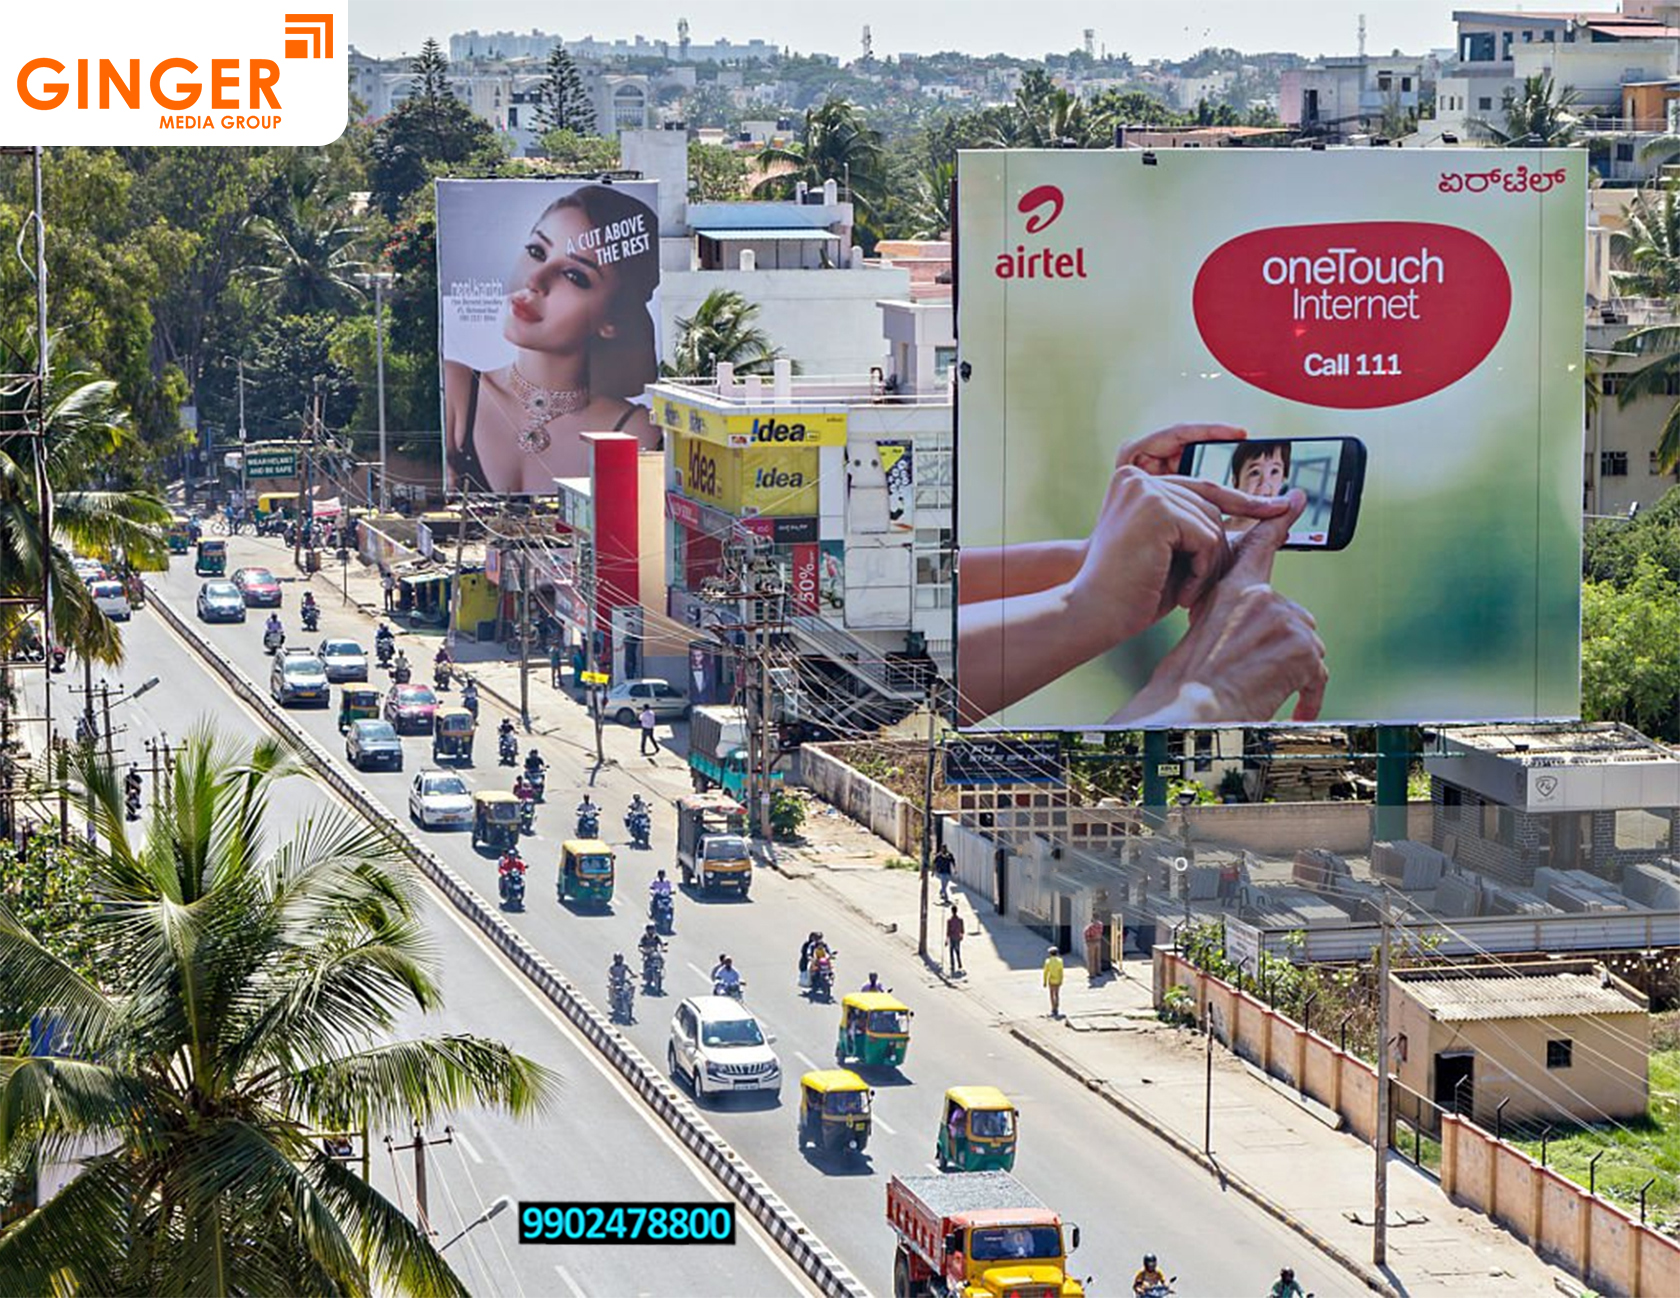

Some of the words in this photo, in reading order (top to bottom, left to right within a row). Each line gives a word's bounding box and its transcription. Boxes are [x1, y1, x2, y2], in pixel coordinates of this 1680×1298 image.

[566, 238, 576, 255] A
[579, 229, 602, 252] CUT
[605, 214, 646, 242] ABOVE
[596, 244, 620, 265] THE
[623, 233, 651, 259] REST
[995, 246, 1087, 280] airtel
[1262, 247, 1445, 286] oneTouch
[1293, 288, 1420, 322] Internet
[1304, 353, 1350, 376] Call
[1355, 354, 1402, 376] 111
[798, 562, 816, 604] 50%
